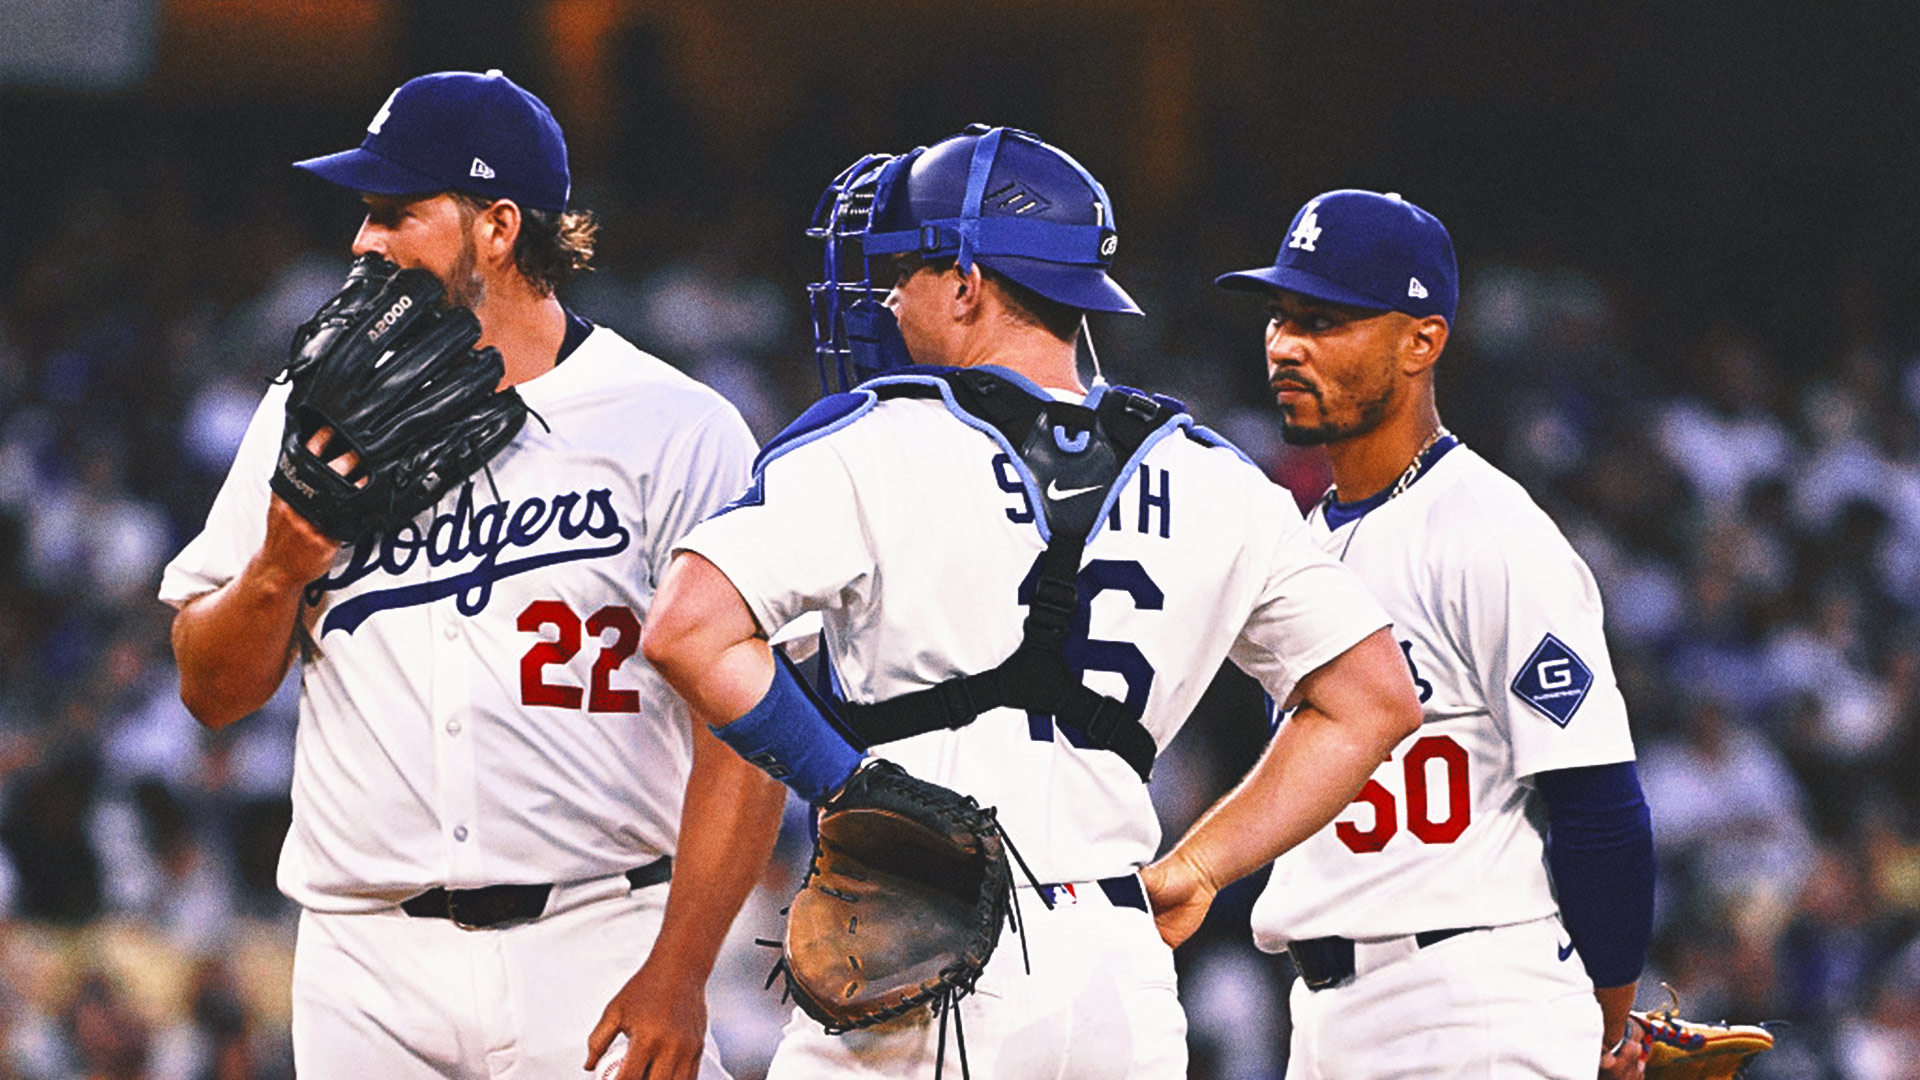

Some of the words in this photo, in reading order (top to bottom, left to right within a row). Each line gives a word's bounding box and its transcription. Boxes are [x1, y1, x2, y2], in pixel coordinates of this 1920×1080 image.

[1289, 200, 1322, 252] LA
[367, 294, 413, 344] A2000
[516, 600, 642, 713] 22
[1537, 658, 1572, 689] G
[1335, 735, 1471, 854] 50
